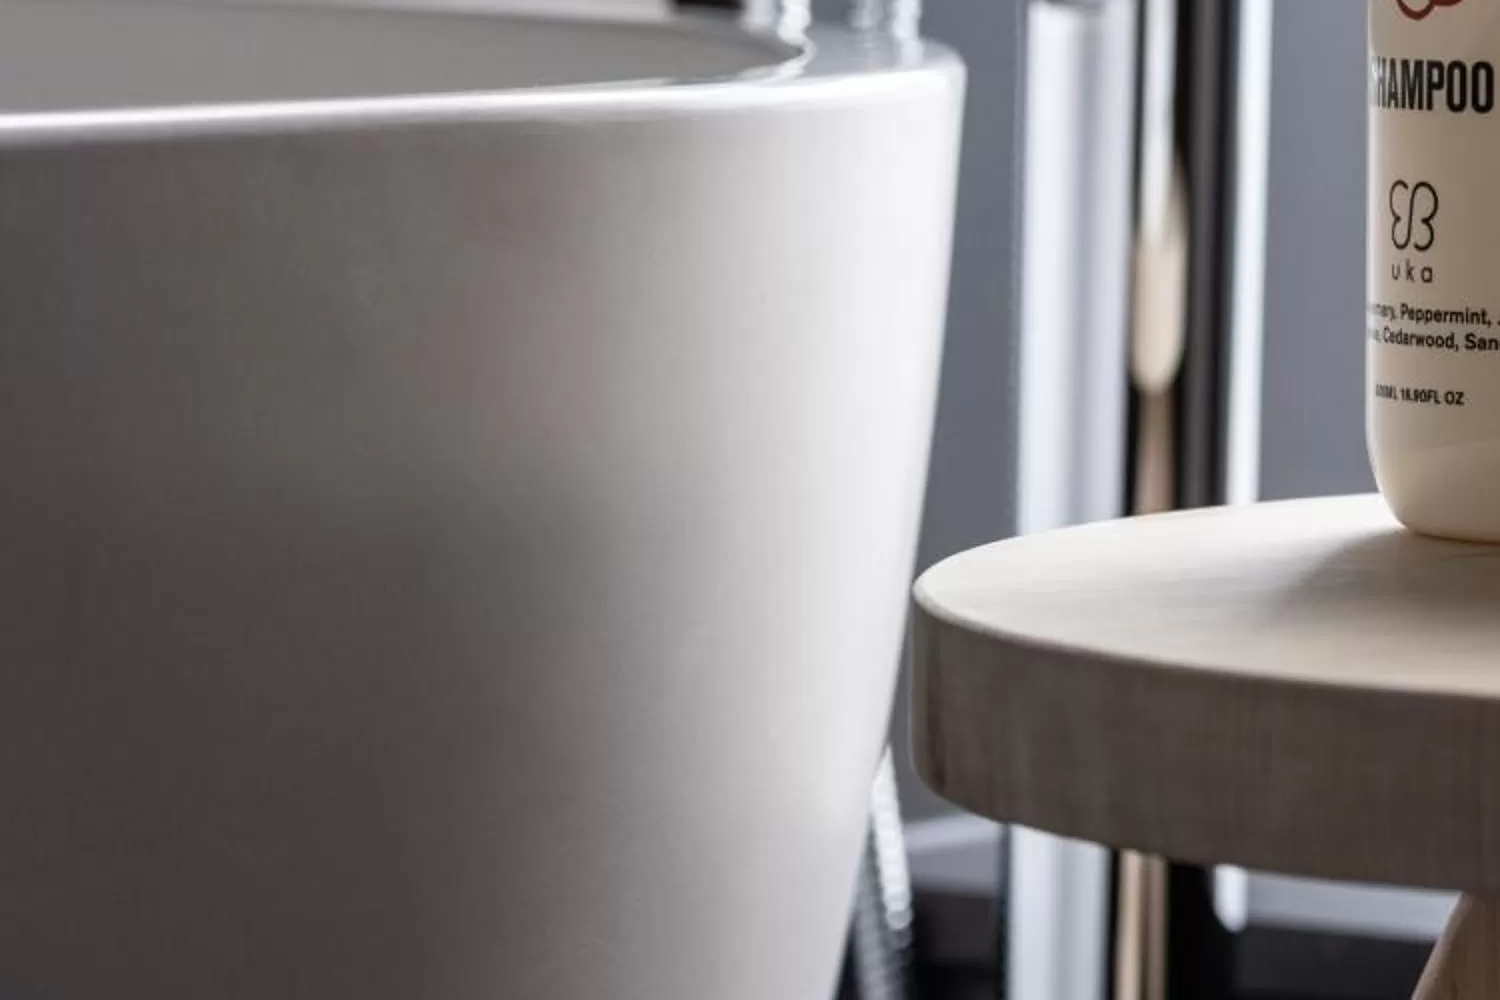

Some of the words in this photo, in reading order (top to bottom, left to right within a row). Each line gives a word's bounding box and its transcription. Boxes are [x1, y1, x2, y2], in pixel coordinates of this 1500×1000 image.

[1370, 55, 1495, 114] HAMPOO
[1391, 260, 1434, 284] uka
[1400, 301, 1492, 327] Peppermint,
[1382, 325, 1459, 352] Cedarwood,
[1444, 390, 1465, 406] OZ
